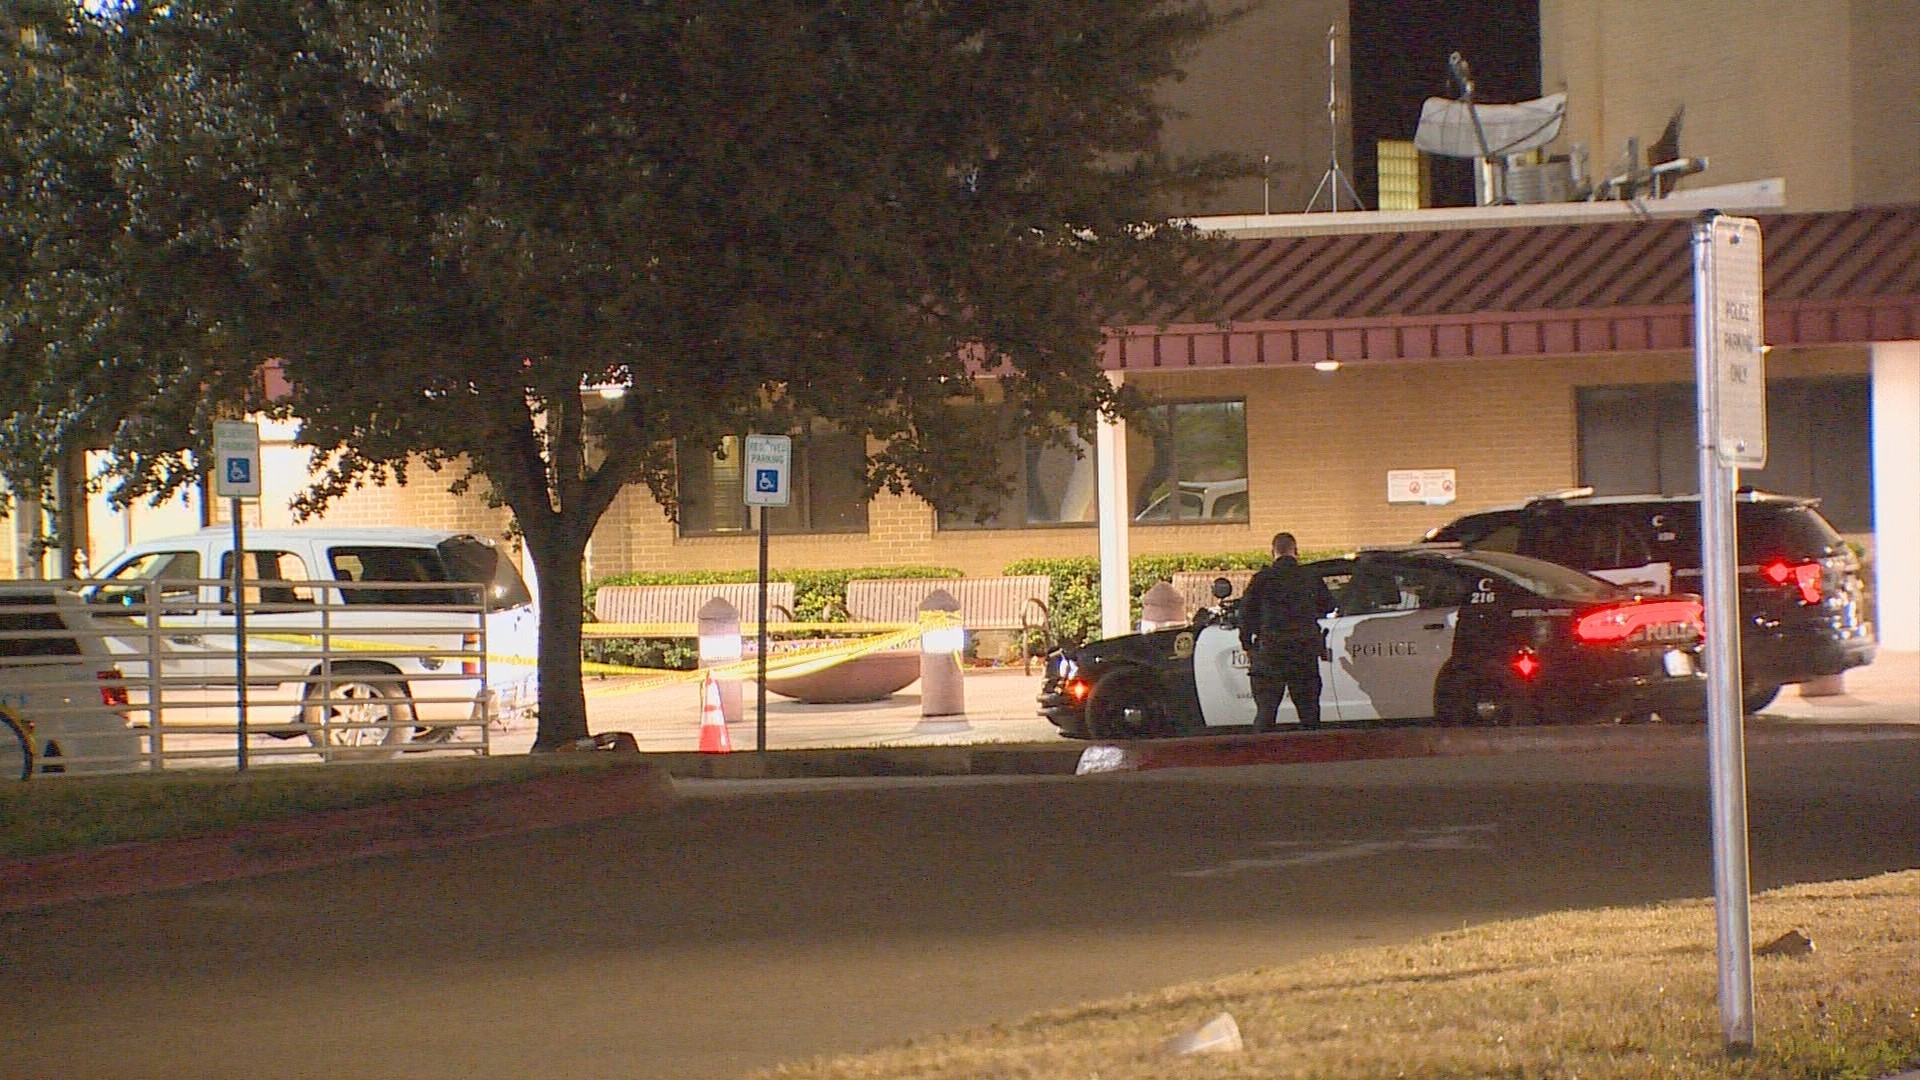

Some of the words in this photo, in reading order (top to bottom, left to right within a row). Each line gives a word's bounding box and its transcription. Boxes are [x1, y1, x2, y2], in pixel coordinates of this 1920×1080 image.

[1726, 302, 1750, 322] POLICE
[750, 454, 785, 464] PARKING
[1651, 514, 1665, 528] C
[1478, 578, 1494, 592] C
[1470, 591, 1496, 604] 216
[1351, 640, 1418, 658] POLICE
